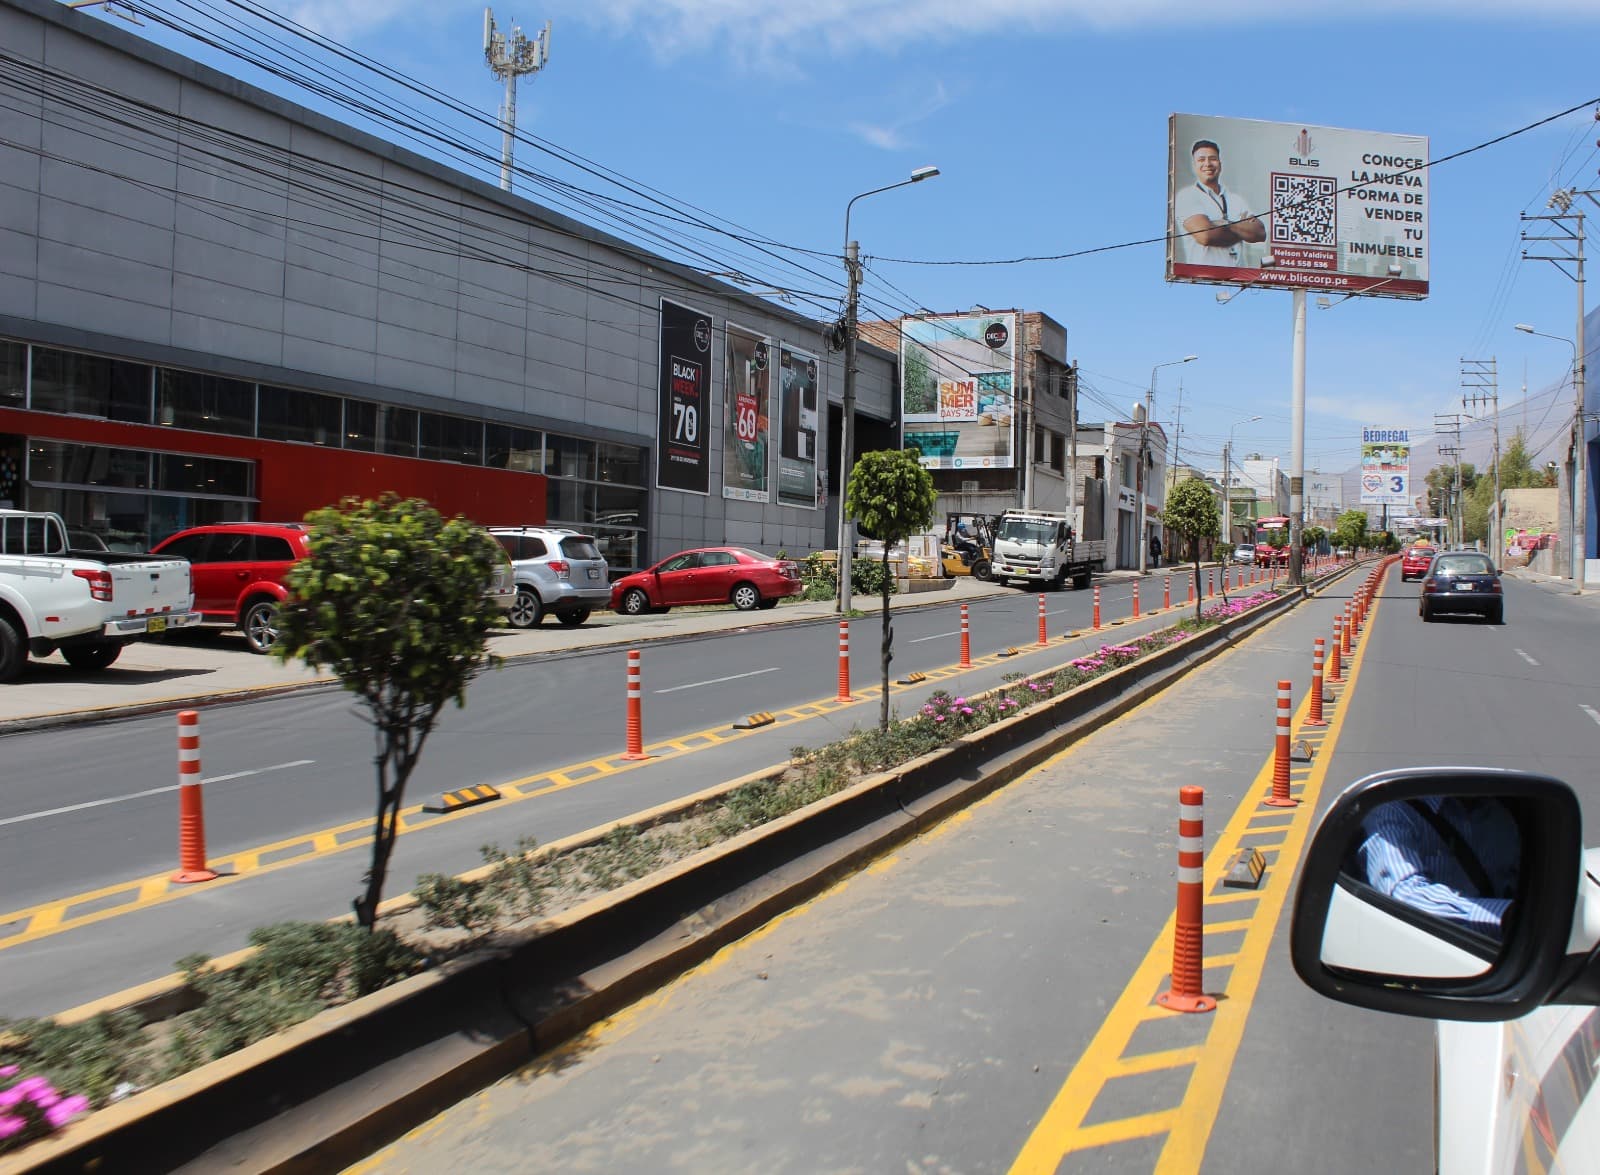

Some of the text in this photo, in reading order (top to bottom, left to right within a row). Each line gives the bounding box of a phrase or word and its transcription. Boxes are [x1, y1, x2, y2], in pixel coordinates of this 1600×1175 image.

[1289, 158, 1320, 167] BLIS
[1362, 154, 1423, 169] CONOCE
[1352, 170, 1422, 187] LA NUEVA
[1348, 189, 1423, 204] FORMA DE
[1364, 208, 1422, 222] VENDER
[1404, 228, 1422, 240] TU
[1303, 251, 1334, 259] Valdivia
[1350, 242, 1423, 258] INMUEBLE
[1260, 272, 1348, 285] www.bliscorp.pe
[673, 363, 695, 380] BLACK
[940, 381, 974, 394] SUM
[940, 394, 974, 408] MER
[940, 409, 961, 417] DAYS
[1364, 430, 1408, 442] BEDREGAL
[1390, 476, 1403, 492] 3
